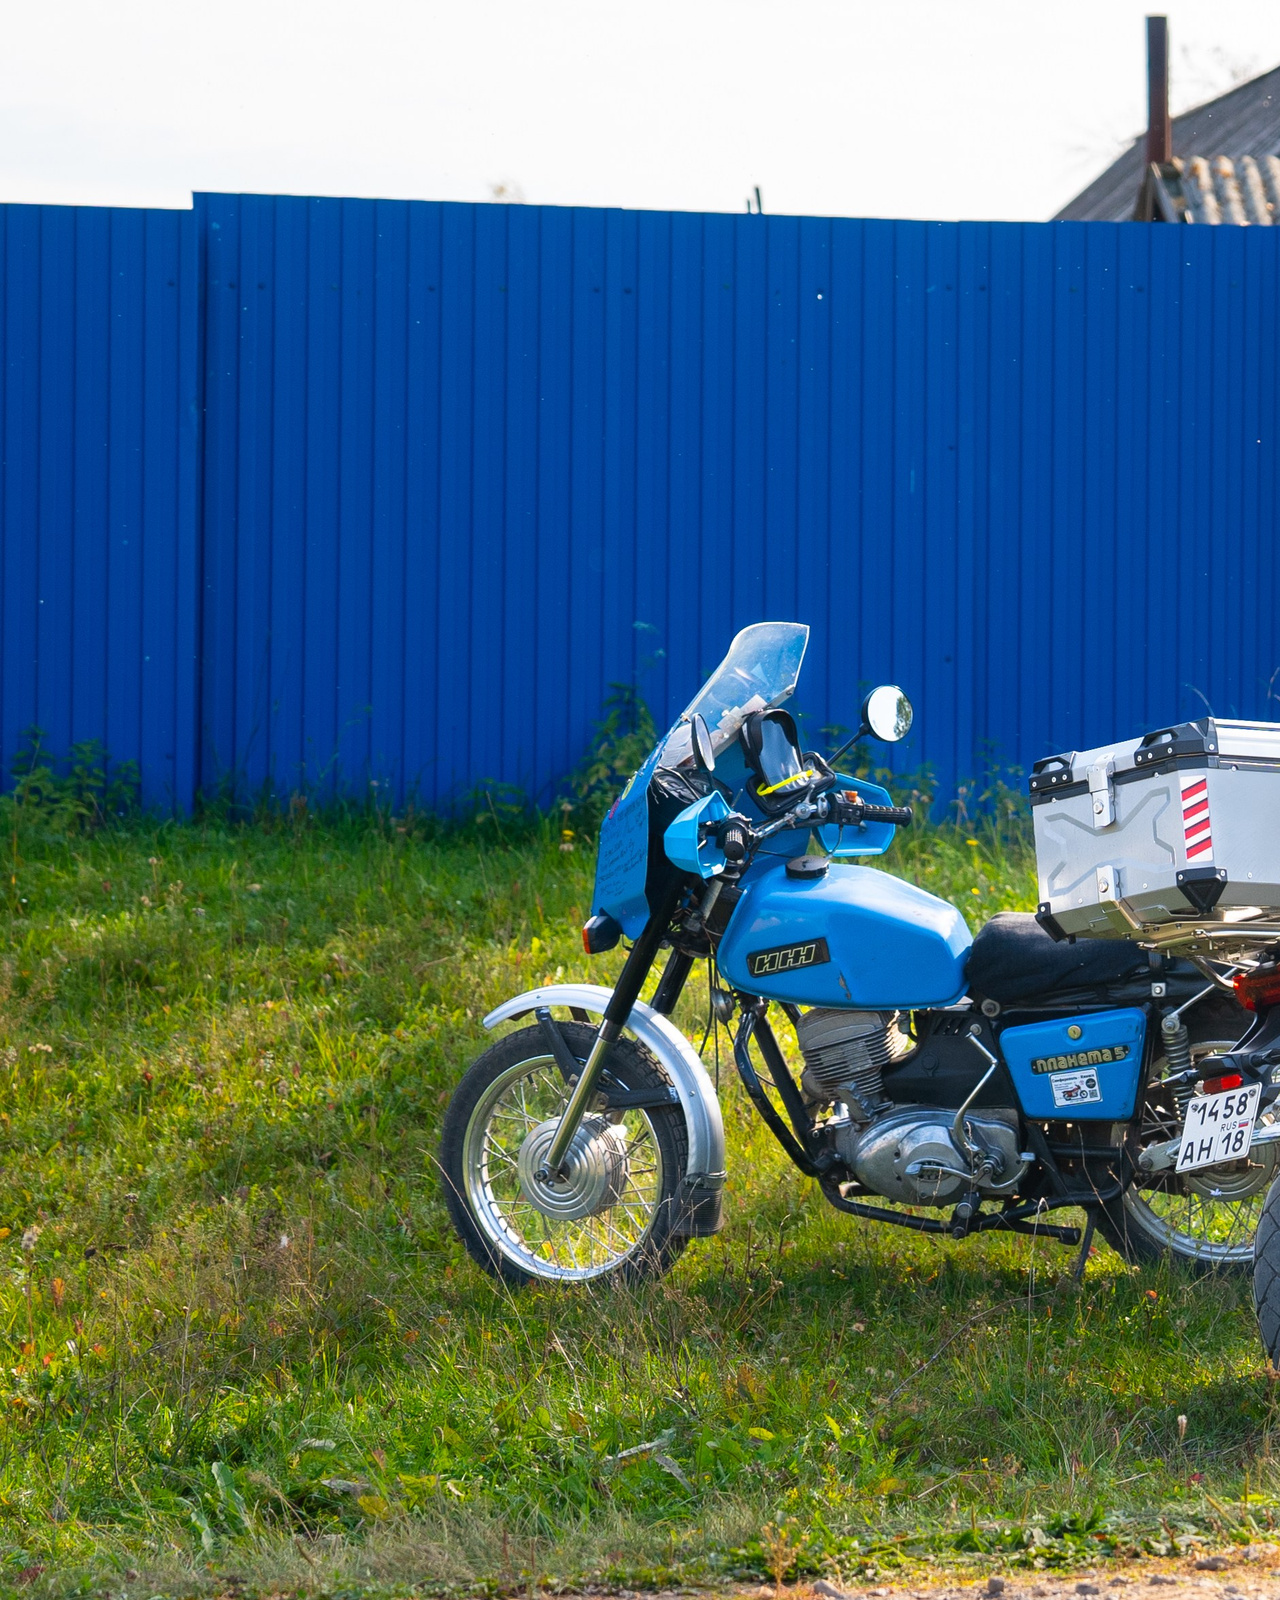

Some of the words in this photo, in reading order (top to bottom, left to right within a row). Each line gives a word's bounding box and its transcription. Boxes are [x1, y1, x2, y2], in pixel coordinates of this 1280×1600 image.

[1114, 1046, 1126, 1060] 5
[1197, 1092, 1249, 1126] 1458
[1220, 1120, 1237, 1132] RUS
[1221, 1129, 1245, 1155] 18
